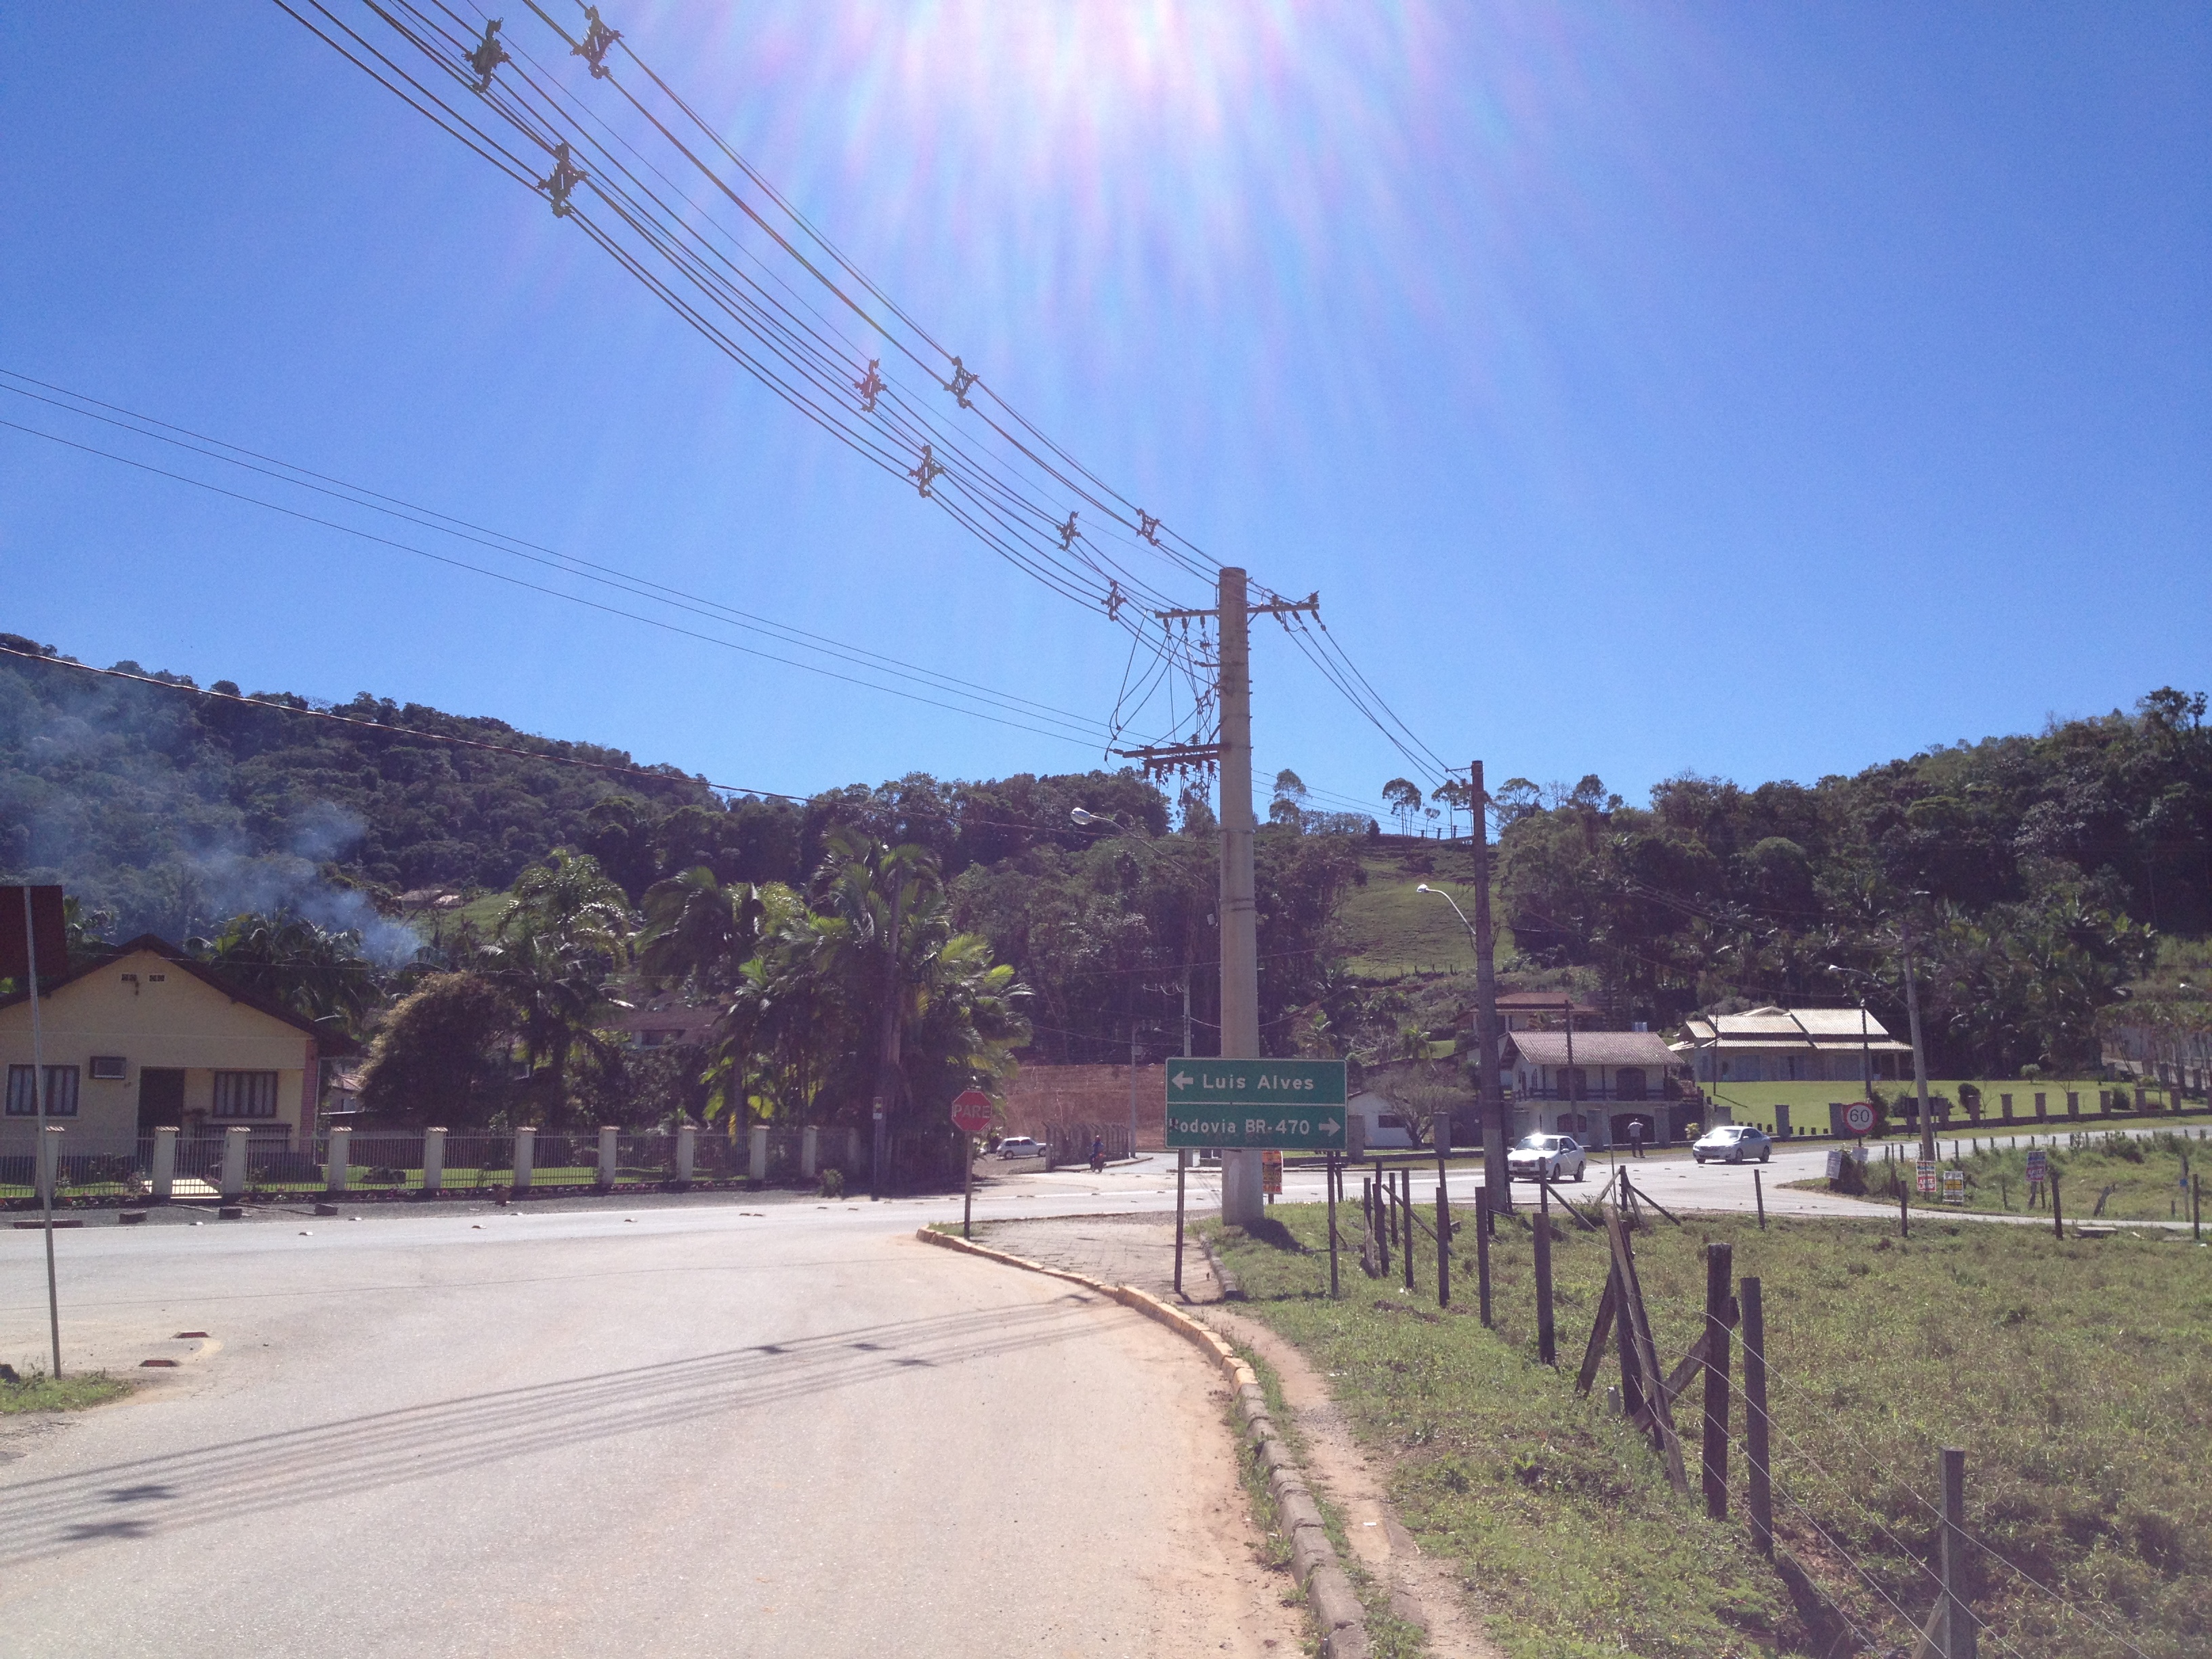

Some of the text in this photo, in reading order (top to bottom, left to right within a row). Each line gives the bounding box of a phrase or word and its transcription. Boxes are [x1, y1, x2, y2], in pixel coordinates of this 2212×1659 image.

[1203, 1073, 1314, 1090] Luis Alves
[954, 1104, 990, 1119] PARE
[1849, 1109, 1870, 1123] 60
[1246, 1119, 1309, 1135] BR-470
